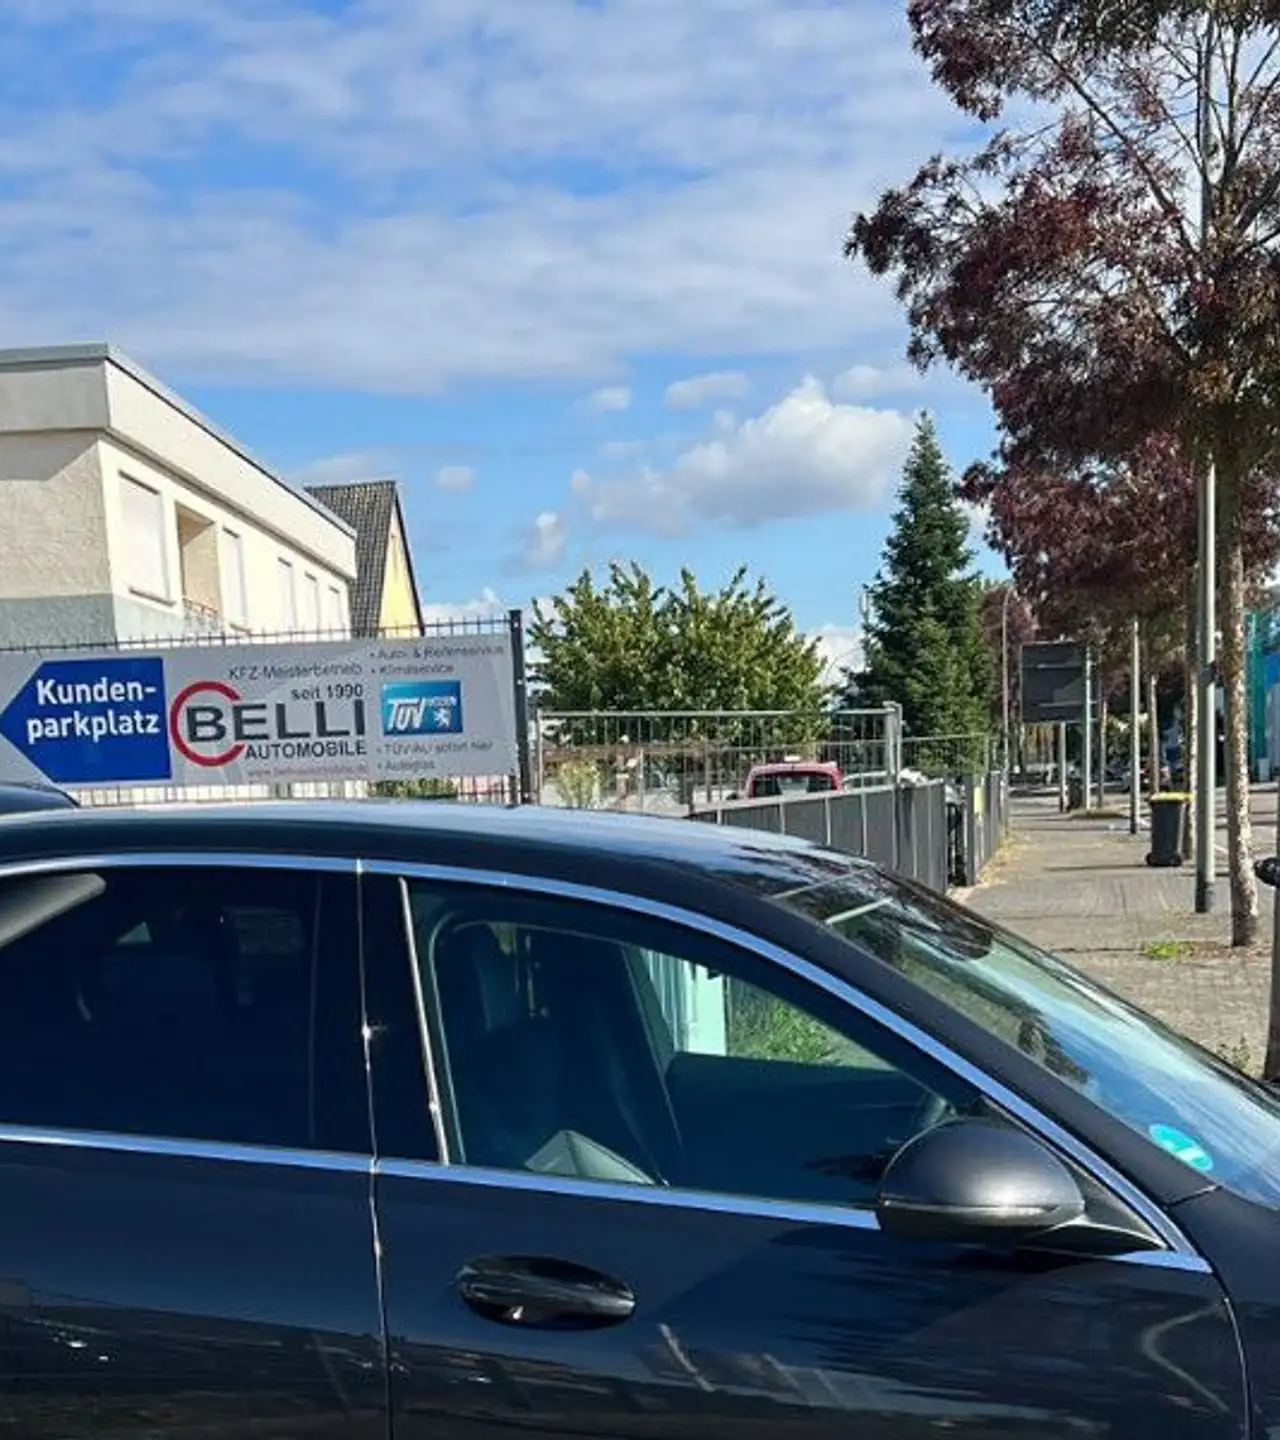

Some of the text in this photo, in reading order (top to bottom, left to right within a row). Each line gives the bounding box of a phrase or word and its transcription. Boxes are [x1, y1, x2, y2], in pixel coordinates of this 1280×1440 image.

[228, 662, 363, 680] KFZ-Meisterbetrieb
[36, 676, 157, 705] Kunden-
[291, 684, 364, 700] seit 1990
[386, 697, 427, 731] TÜV
[26, 709, 161, 745] parkplatz
[246, 740, 367, 760] AUTOMOBILE
